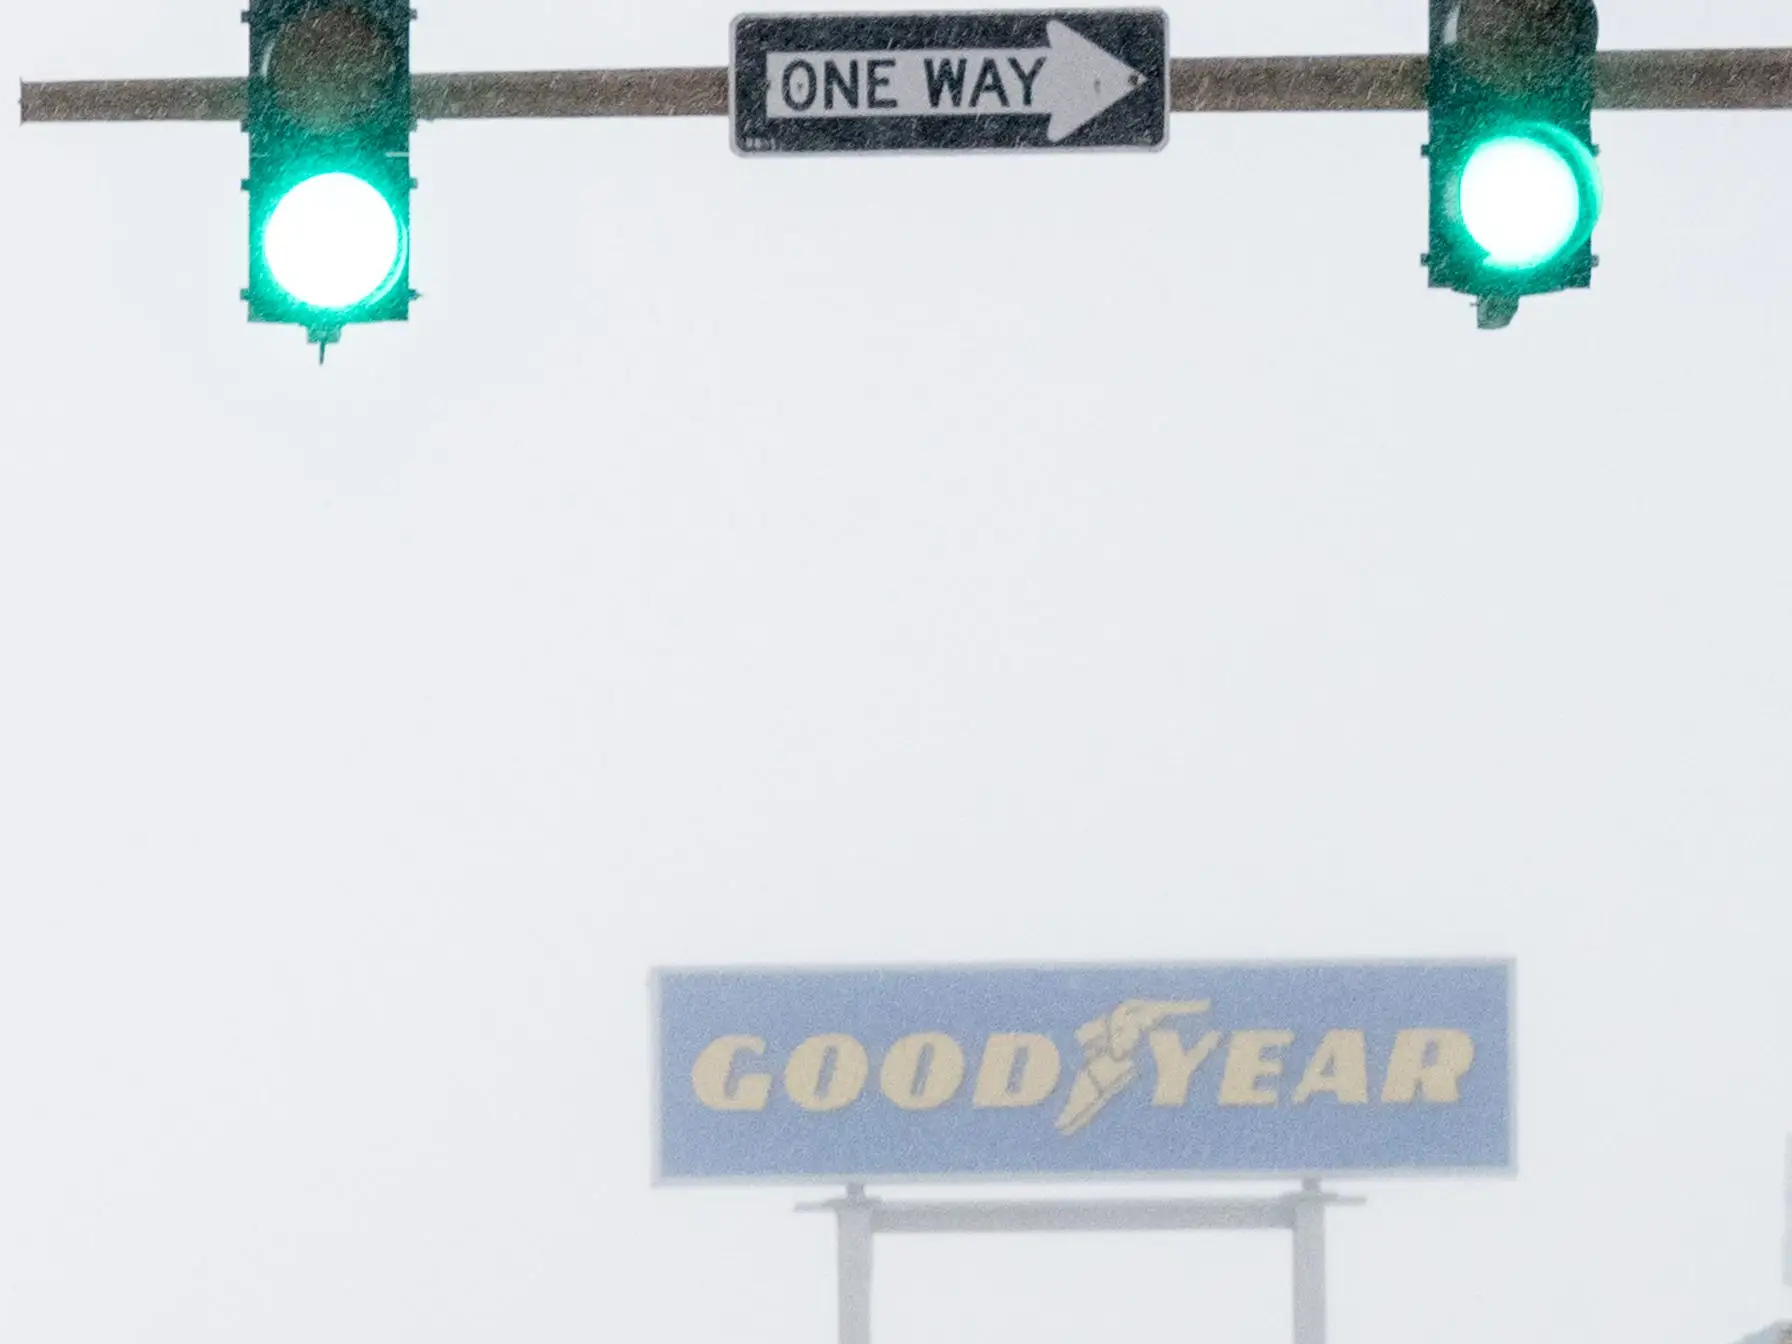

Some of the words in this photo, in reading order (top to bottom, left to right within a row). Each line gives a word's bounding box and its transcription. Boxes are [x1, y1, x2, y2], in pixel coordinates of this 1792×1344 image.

[781, 57, 899, 112] ONE
[923, 55, 1048, 110] WAY
[691, 1026, 1476, 1113] GOODYEAR
